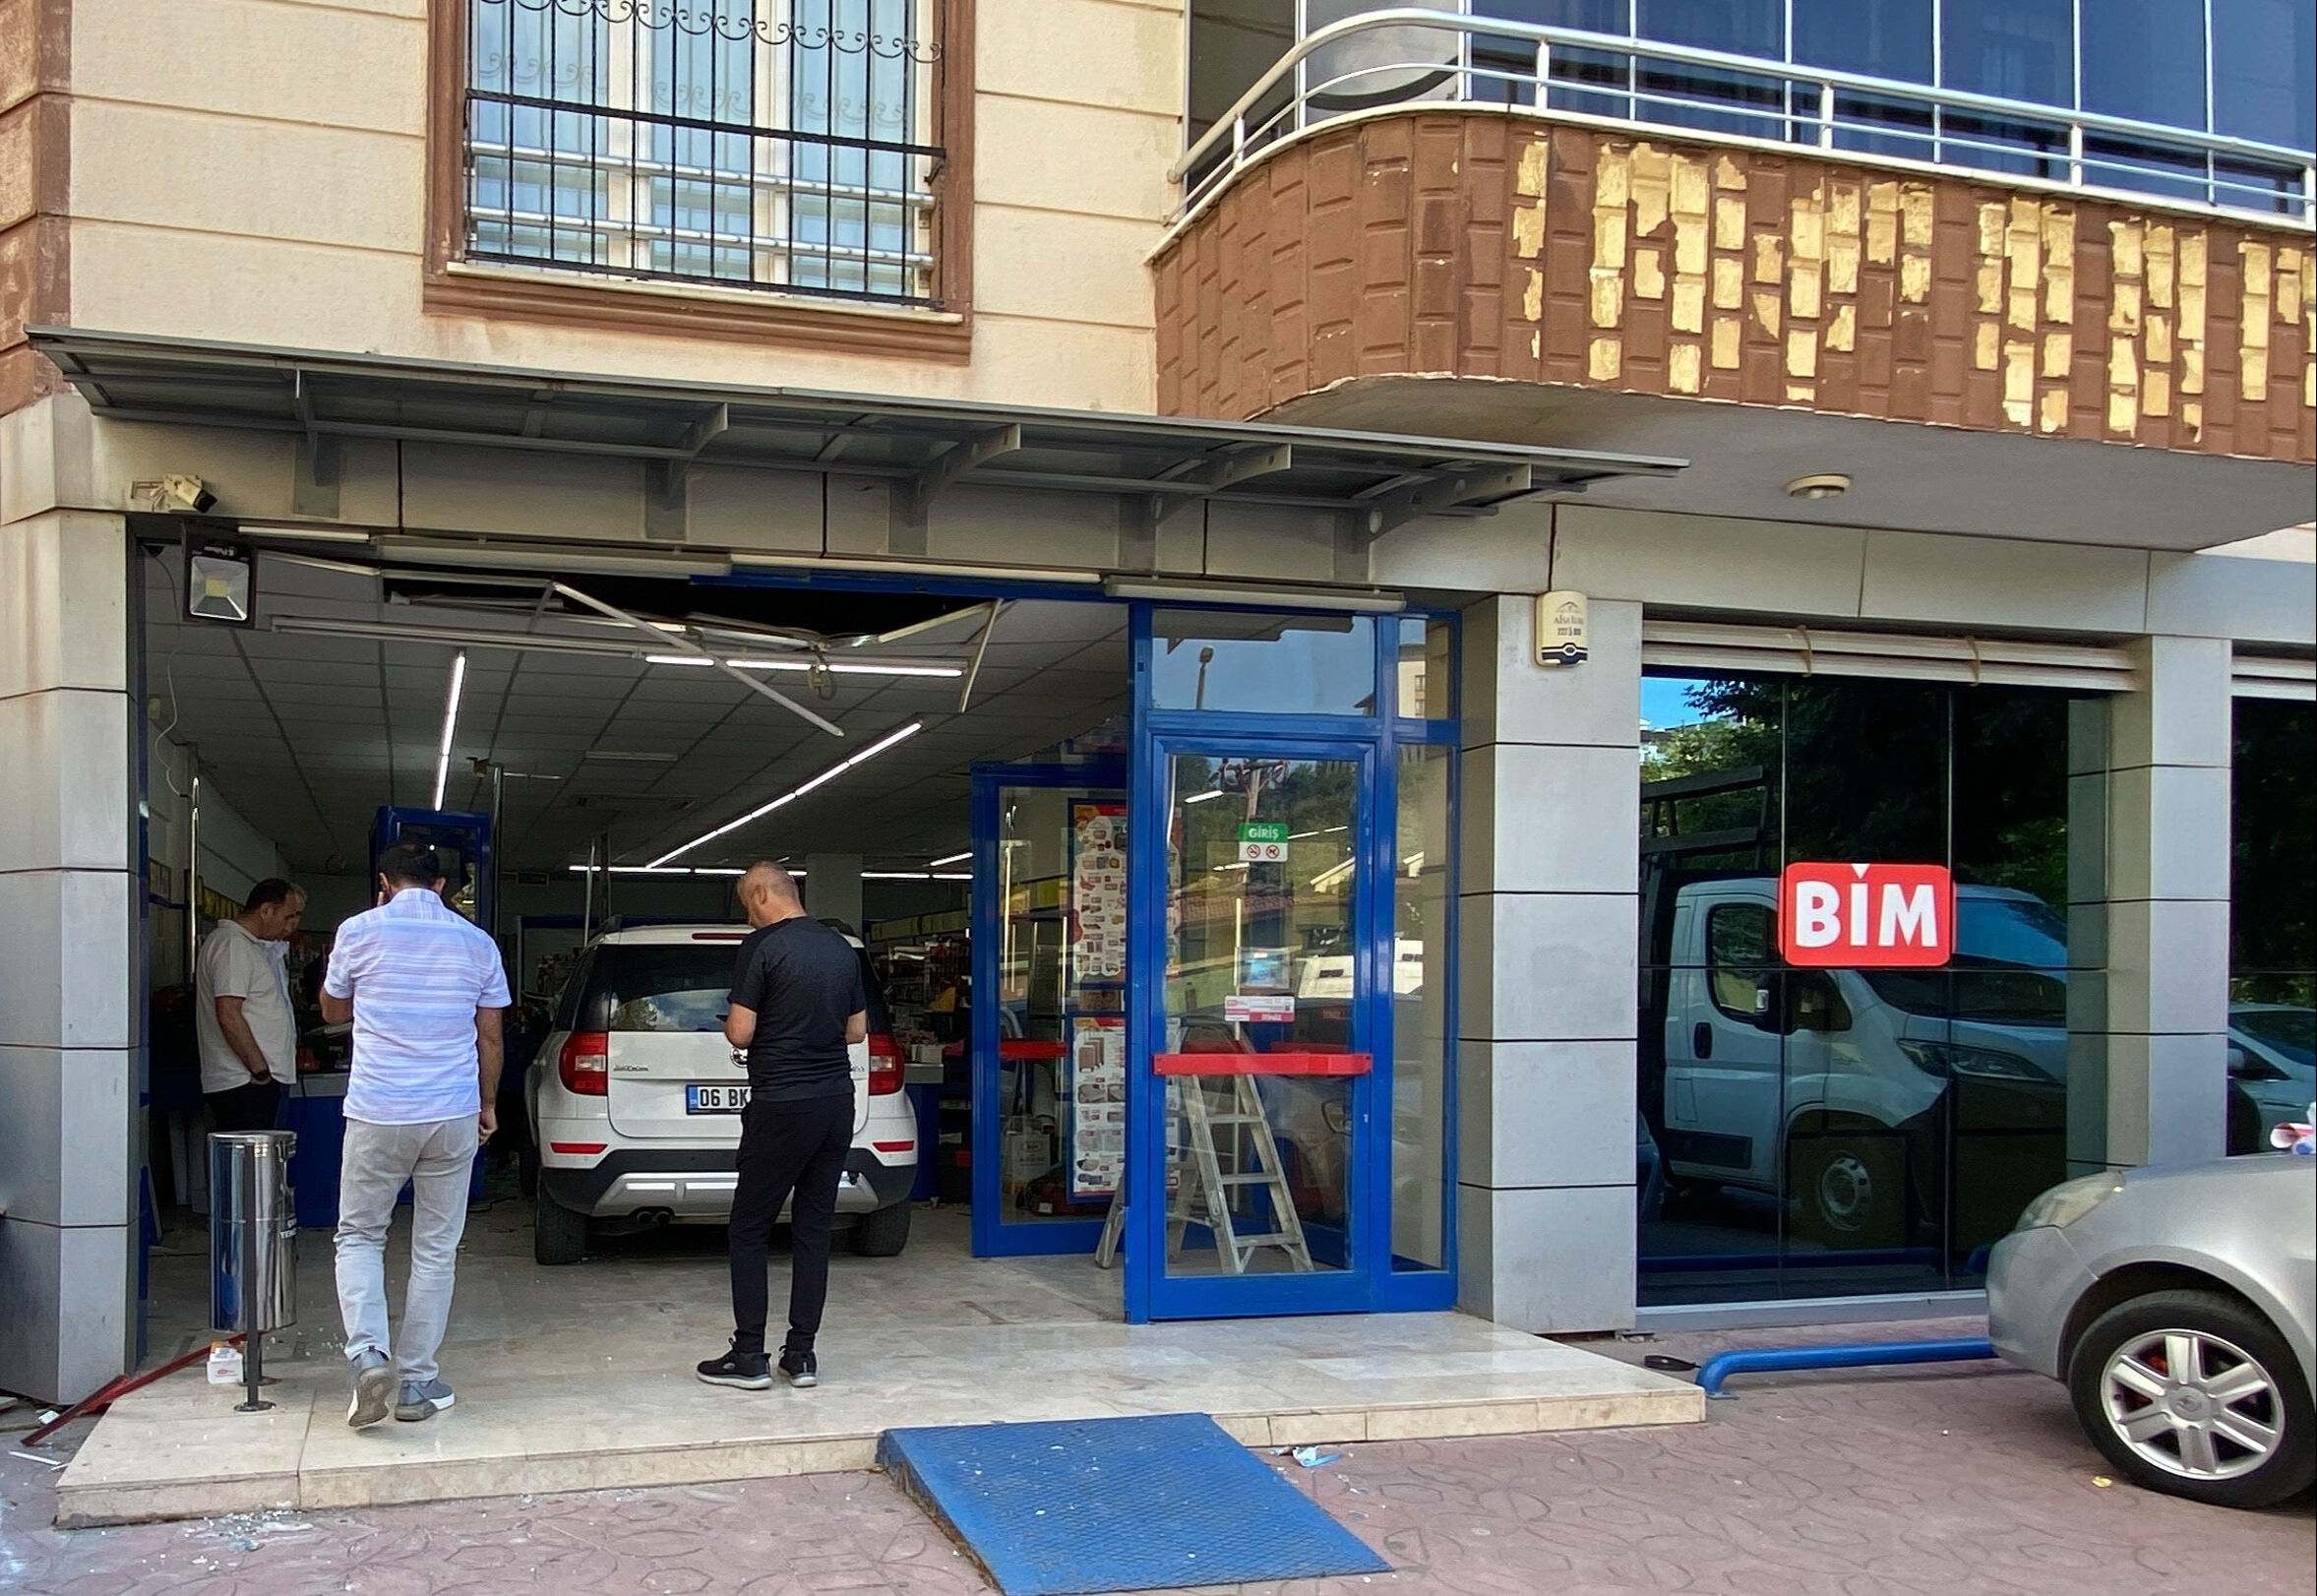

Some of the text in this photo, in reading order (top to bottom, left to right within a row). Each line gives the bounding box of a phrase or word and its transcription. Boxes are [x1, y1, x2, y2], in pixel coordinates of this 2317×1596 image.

[1249, 826, 1279, 841] GİRİŞ
[1796, 863, 1938, 948] BİM
[700, 1088, 749, 1107] 06 BK
